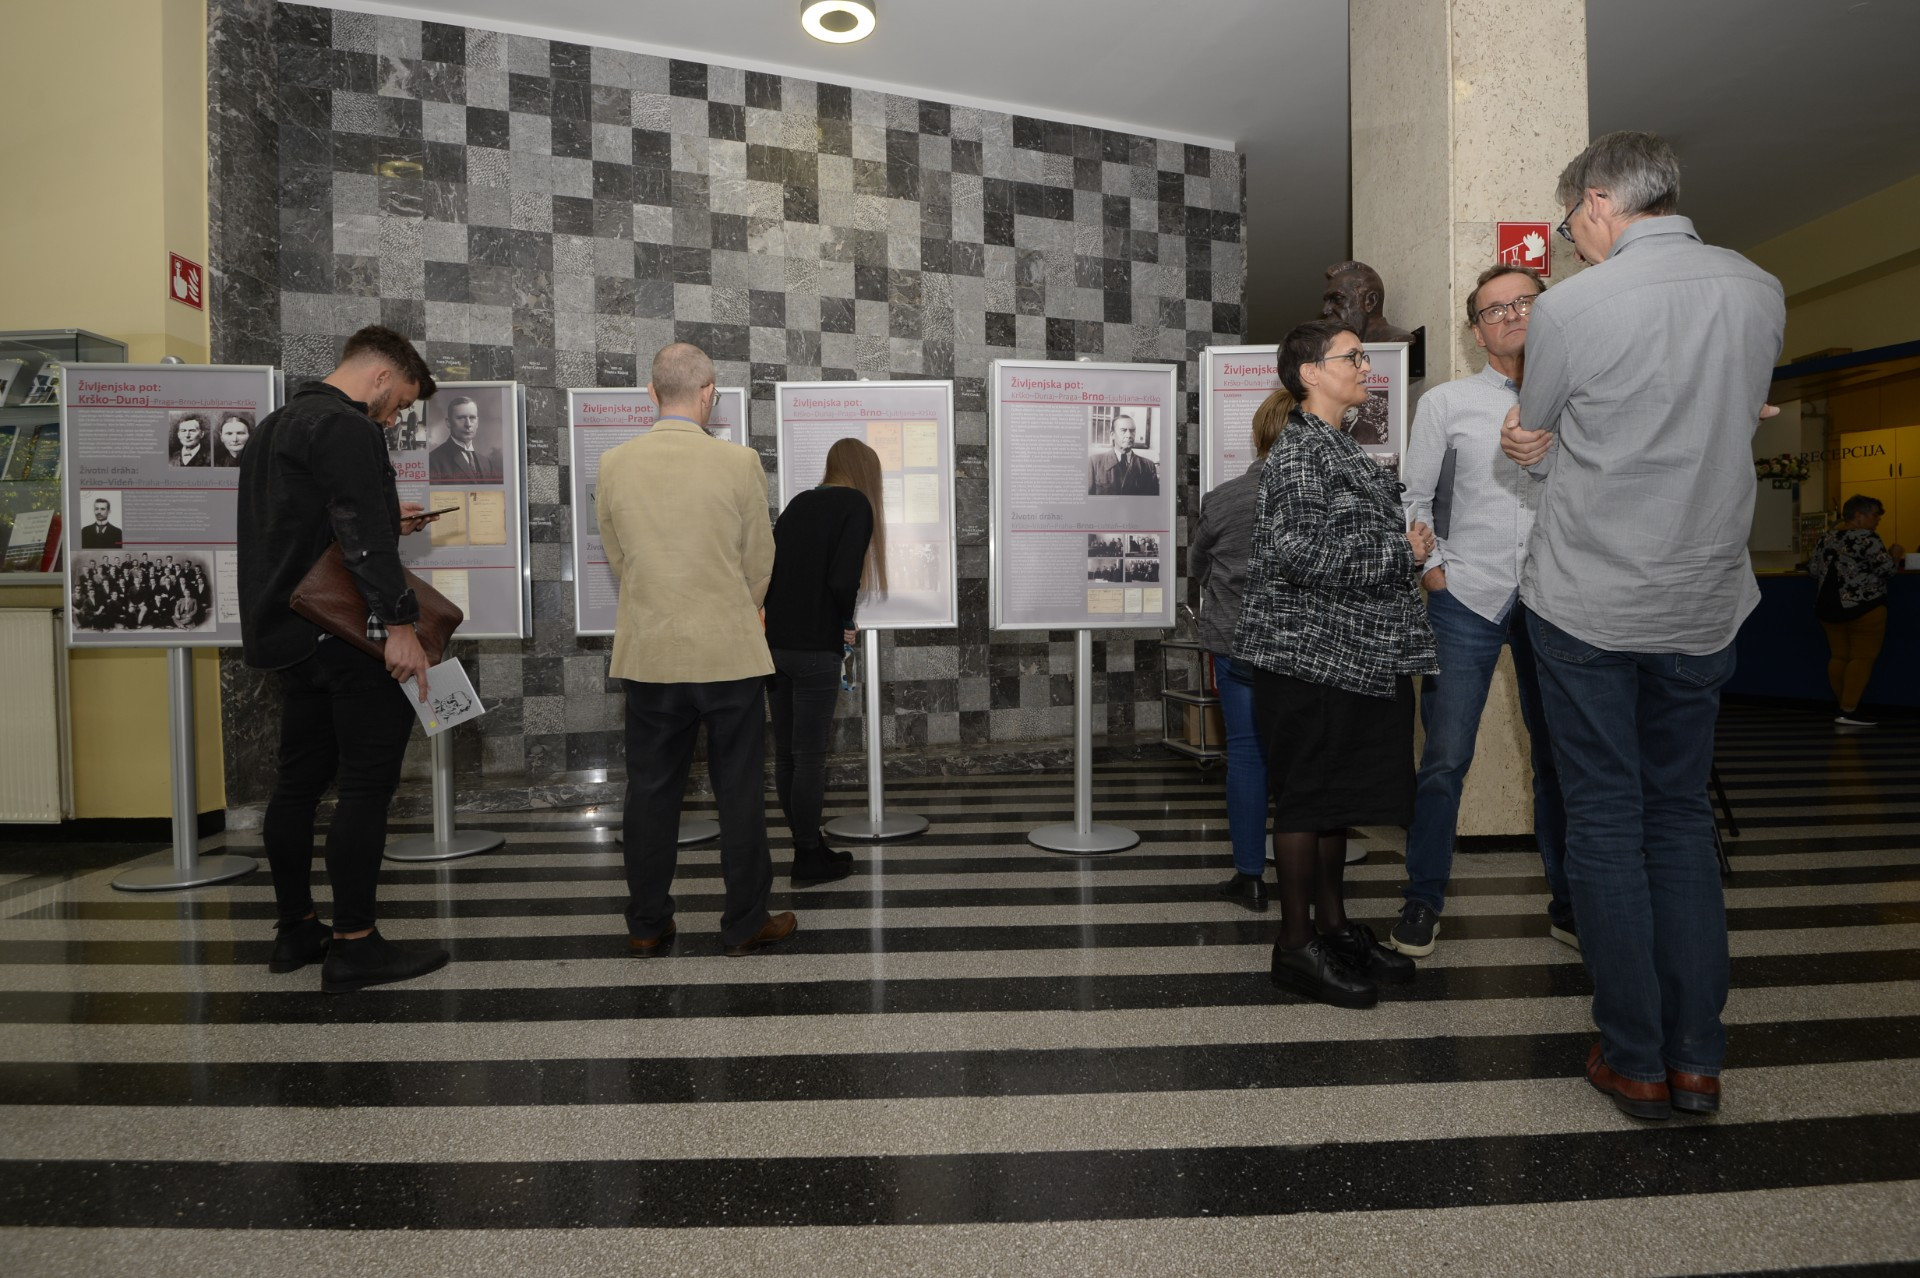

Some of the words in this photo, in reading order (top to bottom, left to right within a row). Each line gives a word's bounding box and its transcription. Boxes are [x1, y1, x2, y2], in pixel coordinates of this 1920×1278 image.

[1223, 364, 1279, 376] Življenjska
[1011, 377, 1062, 390] Življenjska
[1064, 381, 1084, 391] pot:
[1364, 374, 1389, 384] rško
[78, 380, 135, 393] Življenjska
[139, 383, 162, 393] pot:
[583, 403, 632, 414] Življenjska
[635, 404, 654, 414] pot:
[793, 397, 841, 409] Življenjska
[843, 399, 863, 408] pot:
[1800, 444, 1886, 464] RECEPCIJA
[405, 461, 425, 471] pot:
